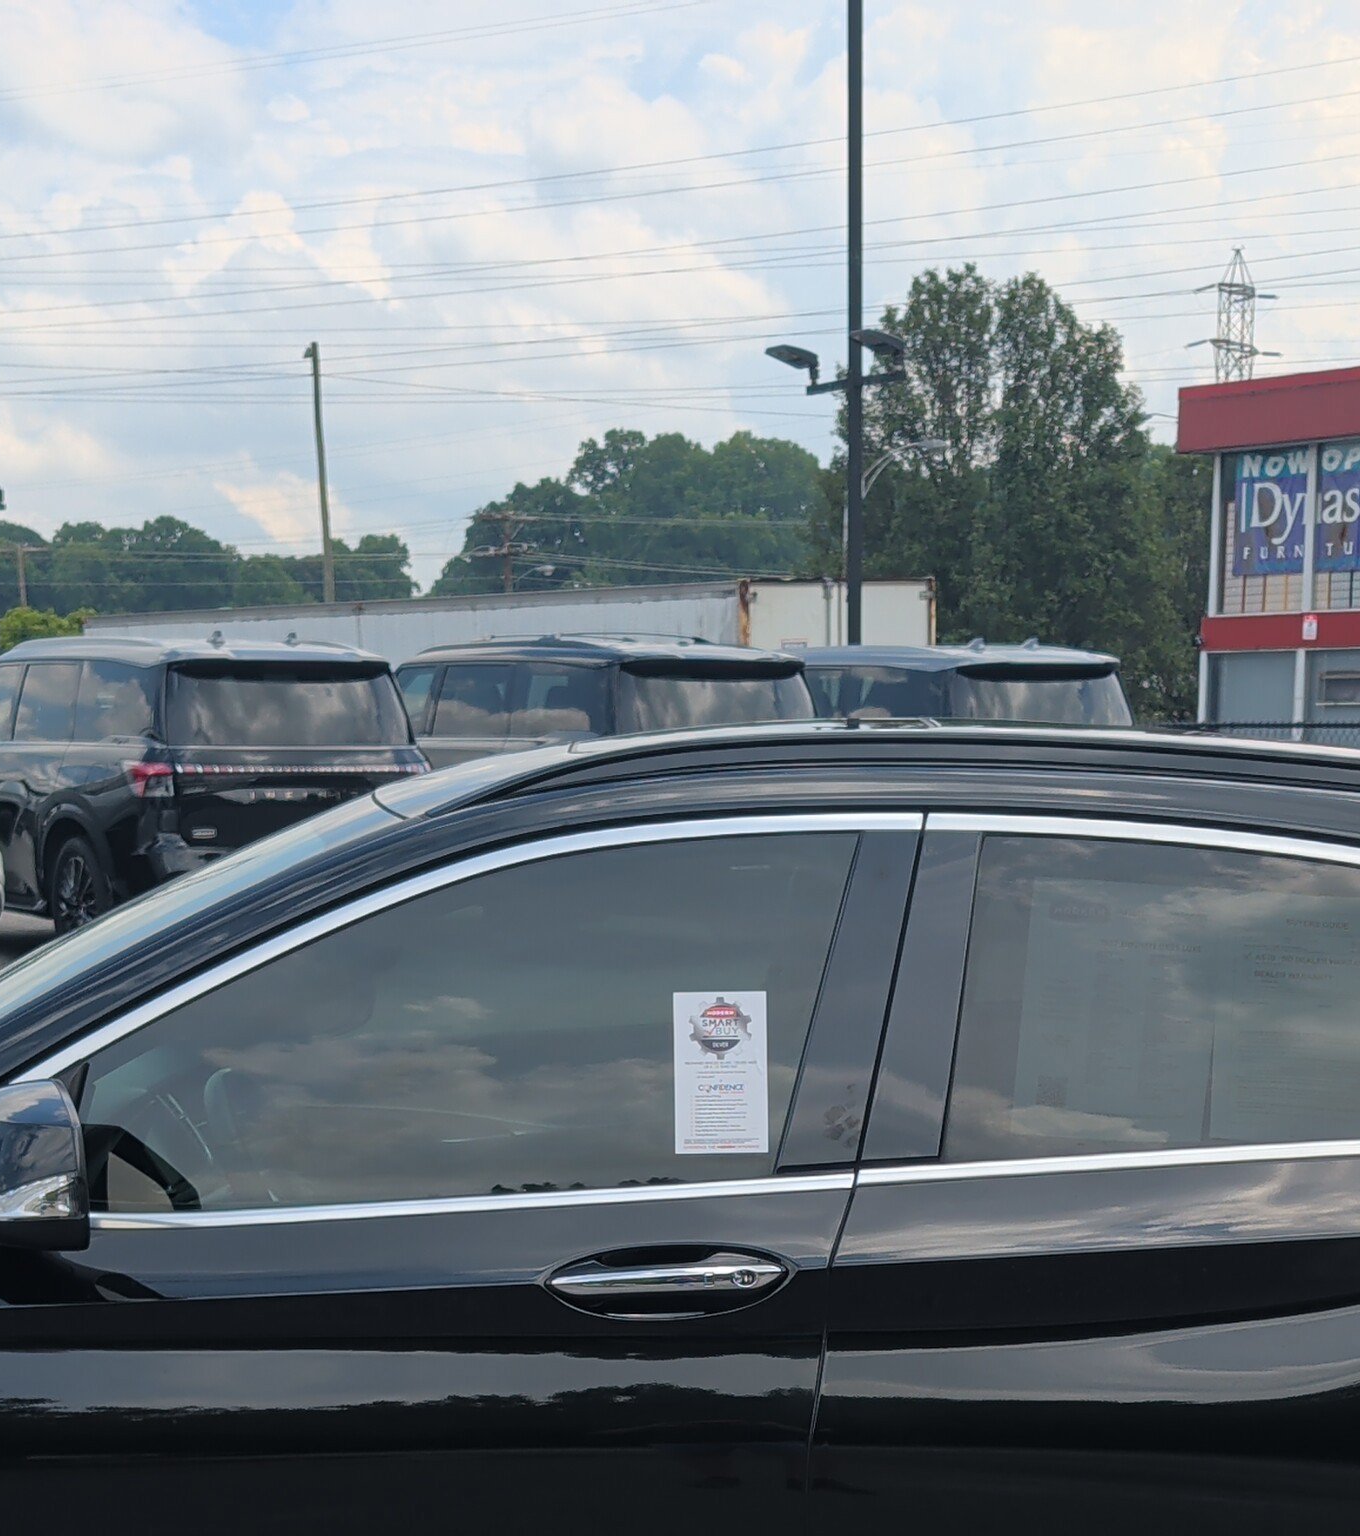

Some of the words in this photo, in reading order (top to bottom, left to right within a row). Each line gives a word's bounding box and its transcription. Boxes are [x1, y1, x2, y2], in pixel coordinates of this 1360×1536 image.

[1242, 450, 1310, 478] NOW
[702, 1019, 739, 1027] SMART
[715, 1027, 739, 1035] BUY
